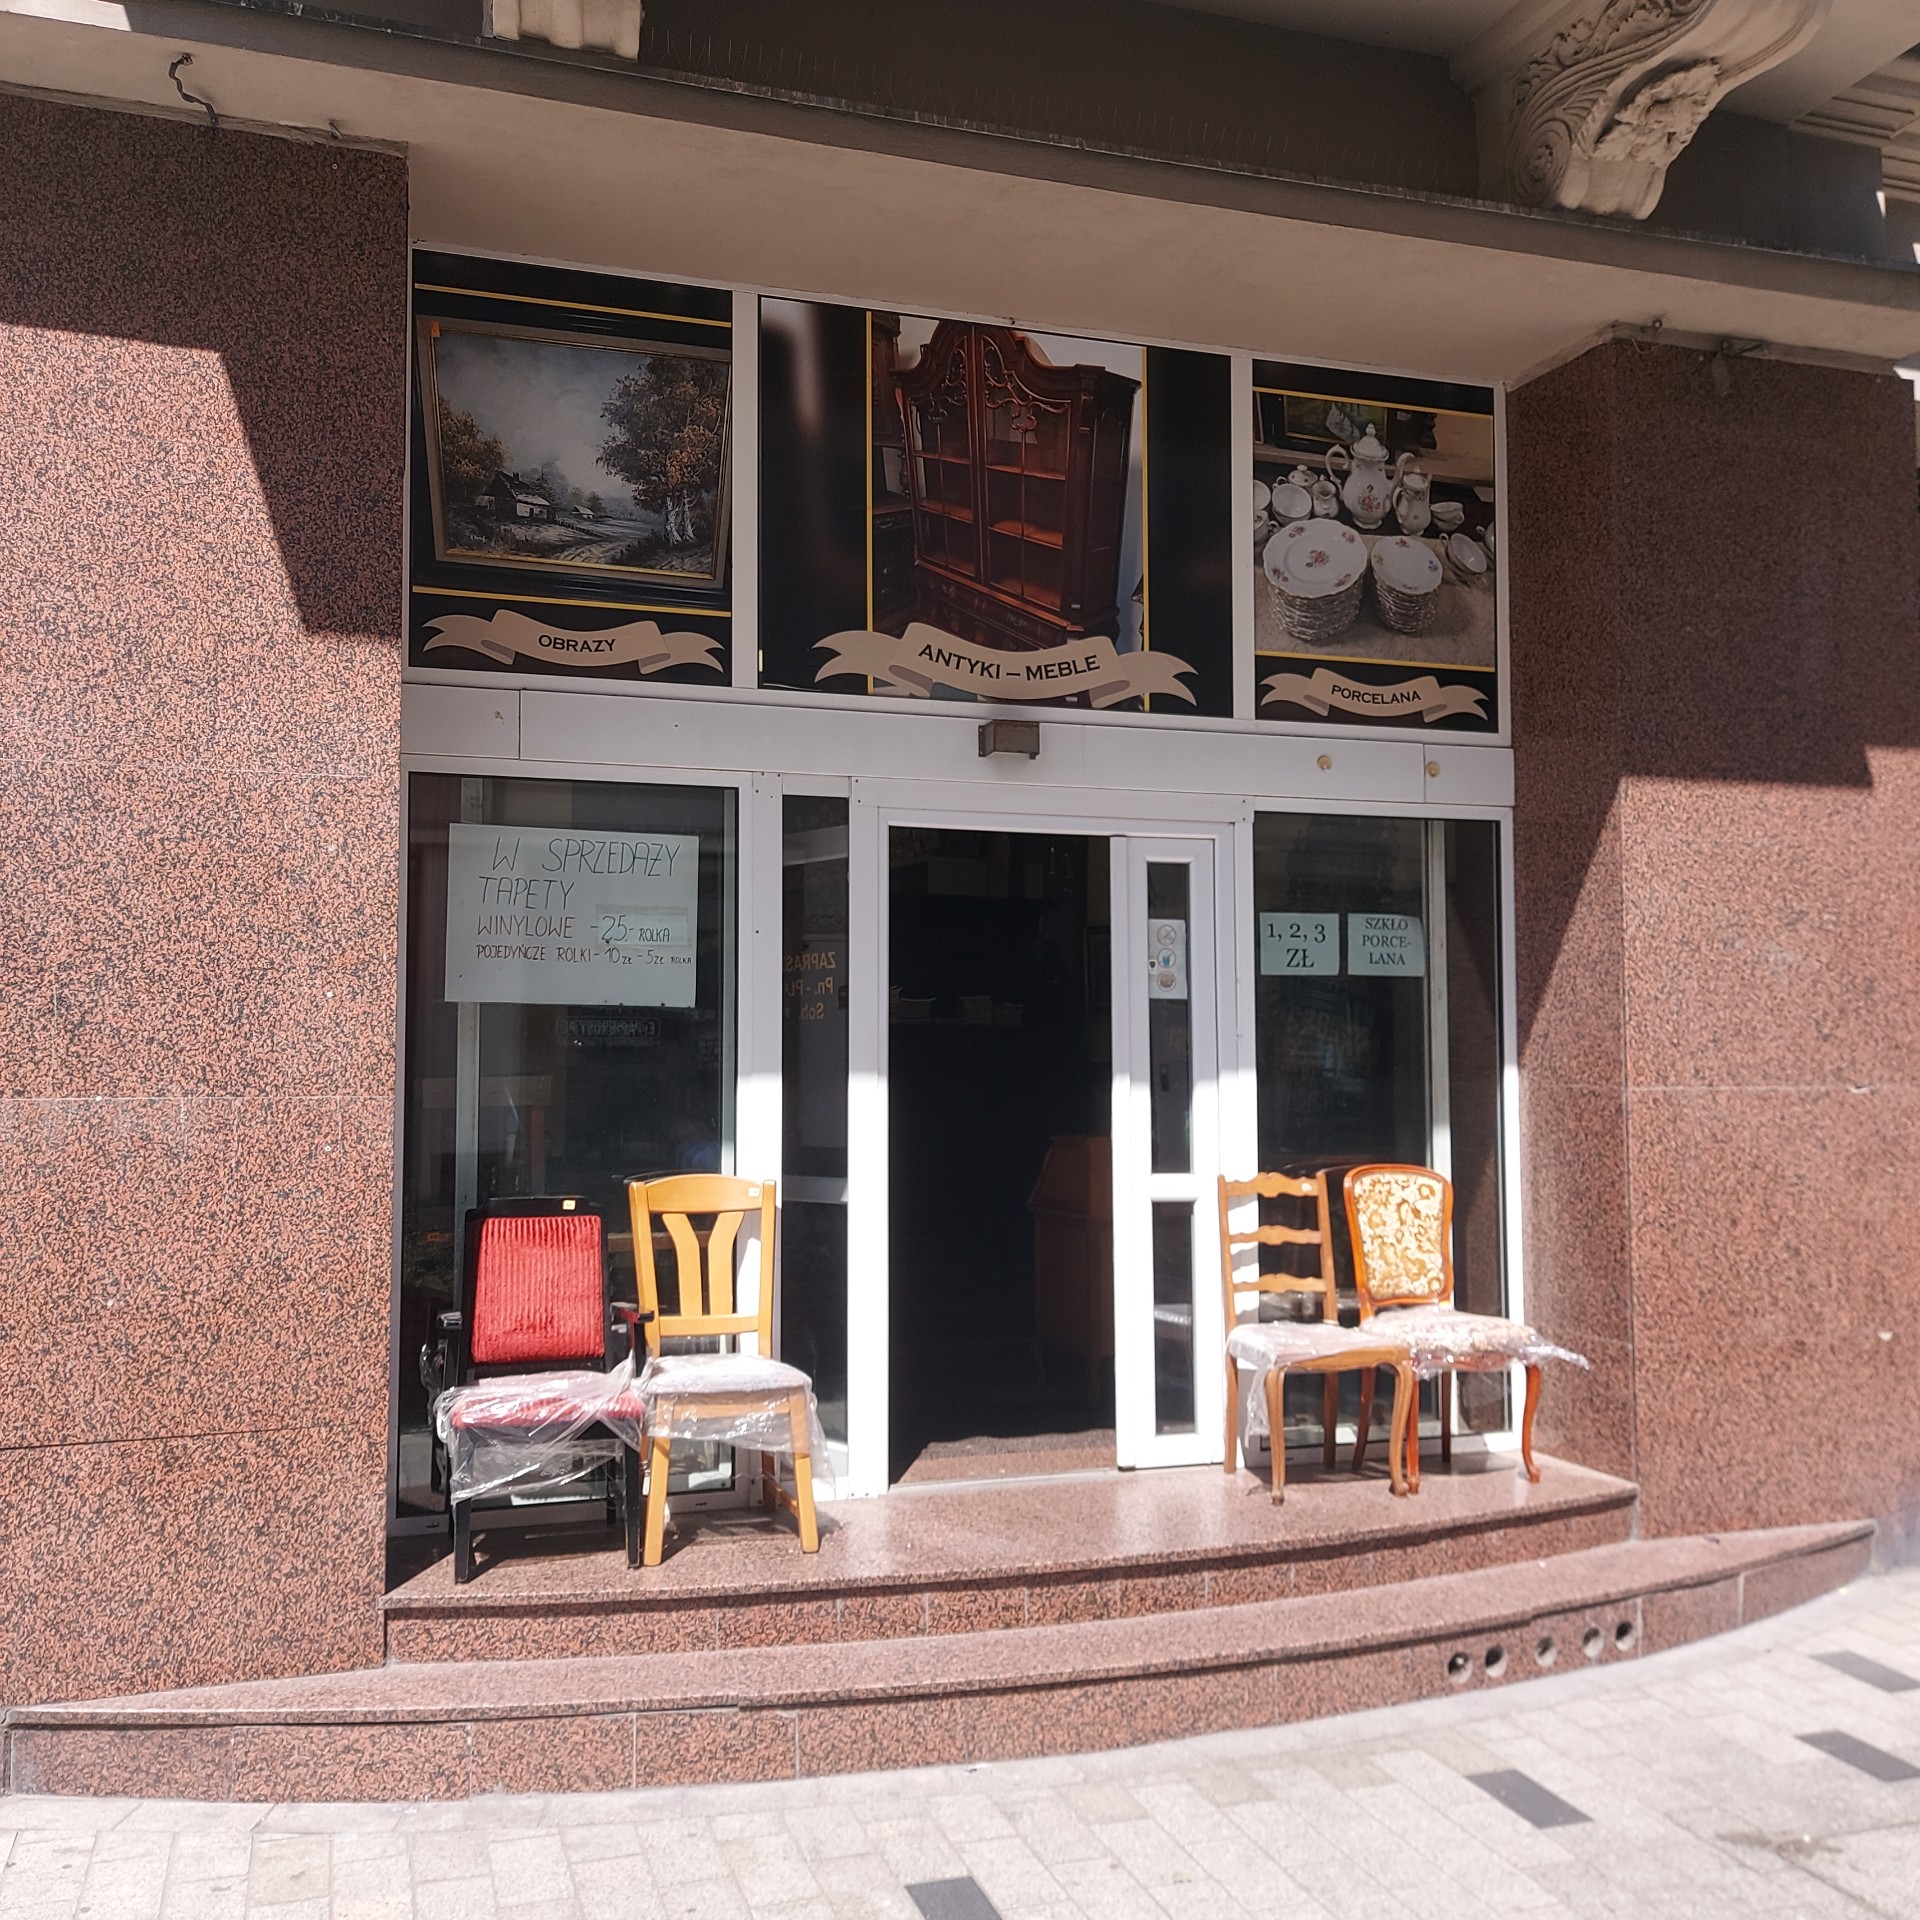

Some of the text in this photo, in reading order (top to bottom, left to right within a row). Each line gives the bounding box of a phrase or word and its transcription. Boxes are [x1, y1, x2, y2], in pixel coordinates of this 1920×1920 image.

[537, 634, 616, 653] OBRAZY
[917, 643, 1000, 680] ANTYKI
[1025, 654, 1100, 681] MEBLE
[1330, 684, 1422, 705] PORCELANA
[491, 836, 521, 872] W
[478, 875, 575, 910] TAPETY
[476, 914, 576, 939] WINYLOWE
[638, 927, 670, 942] ROLKA
[1314, 923, 1326, 944] 3
[1364, 917, 1408, 932] SZKŁO
[1361, 934, 1412, 949] PORCE-
[1286, 948, 1315, 968] ZŁ
[1368, 952, 1406, 966] LANA
